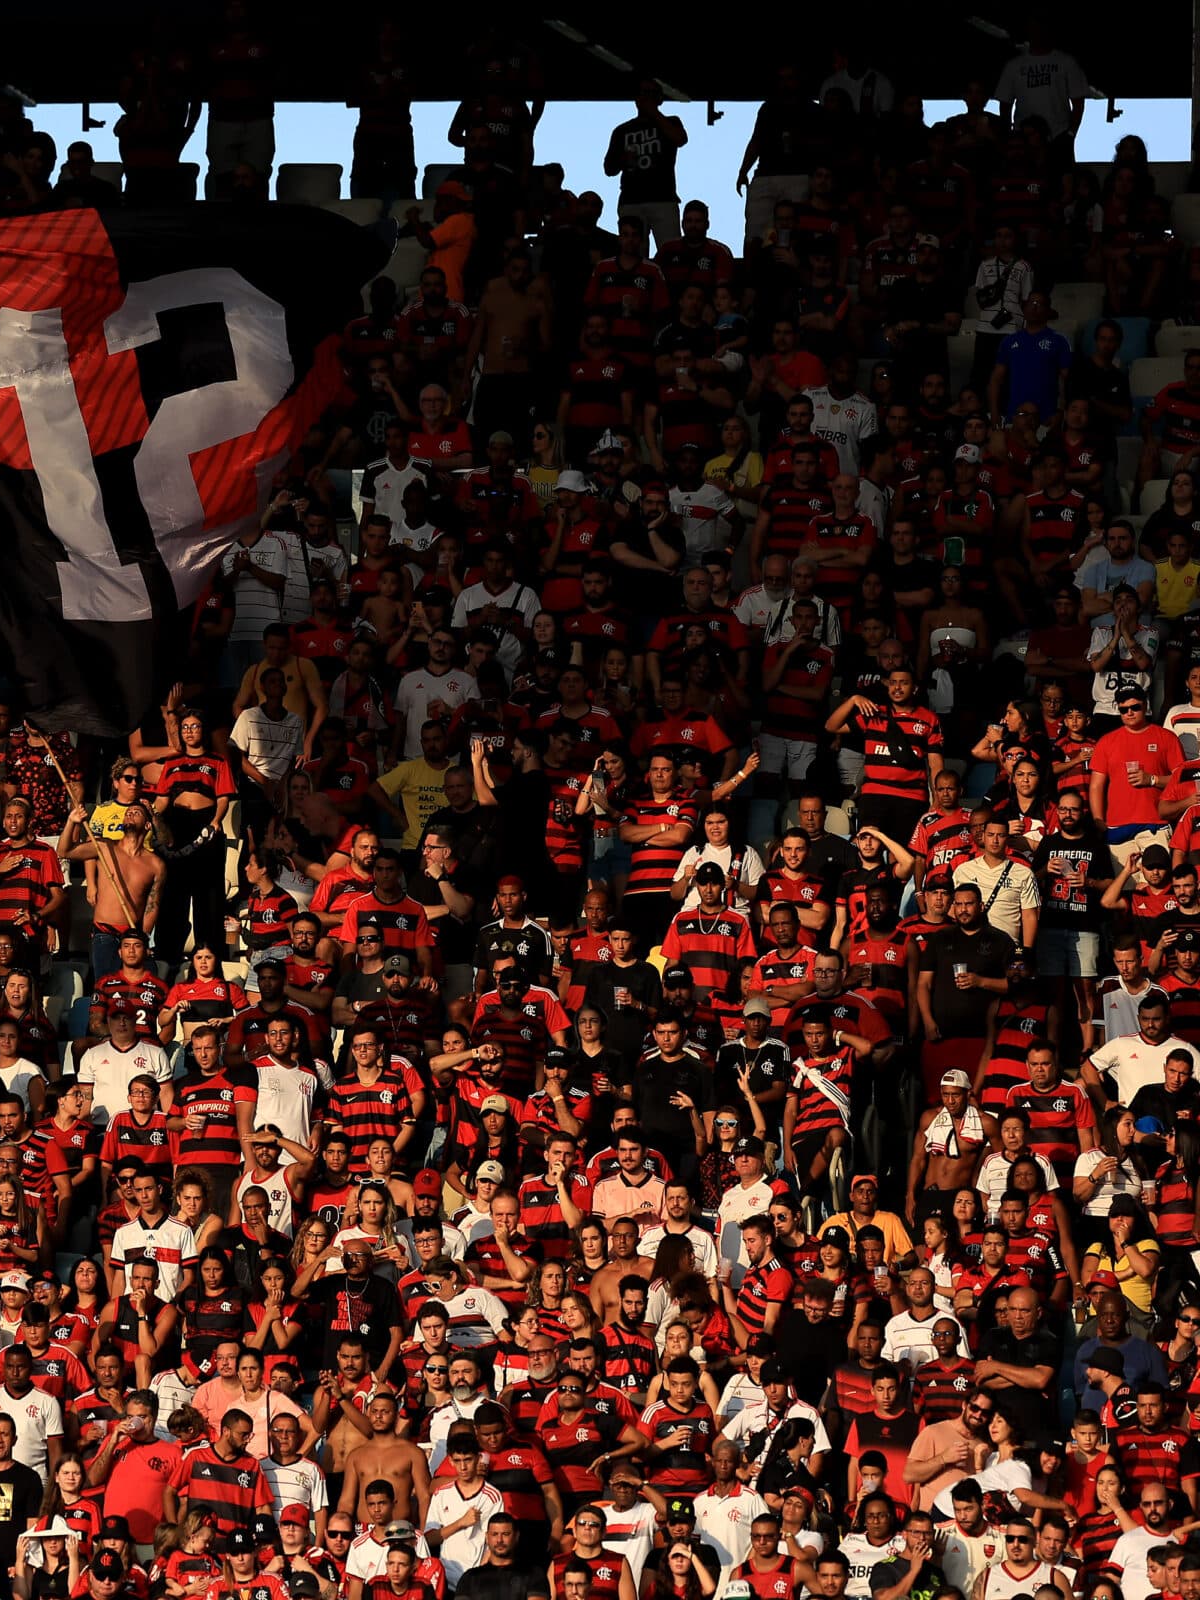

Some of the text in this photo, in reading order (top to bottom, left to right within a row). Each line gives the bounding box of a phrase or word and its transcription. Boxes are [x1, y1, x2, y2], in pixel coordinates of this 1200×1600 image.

[824, 430, 847, 445] BRB
[1049, 851, 1093, 862] FLAMENGO
[188, 1102, 232, 1115] OLYMPIKUS
